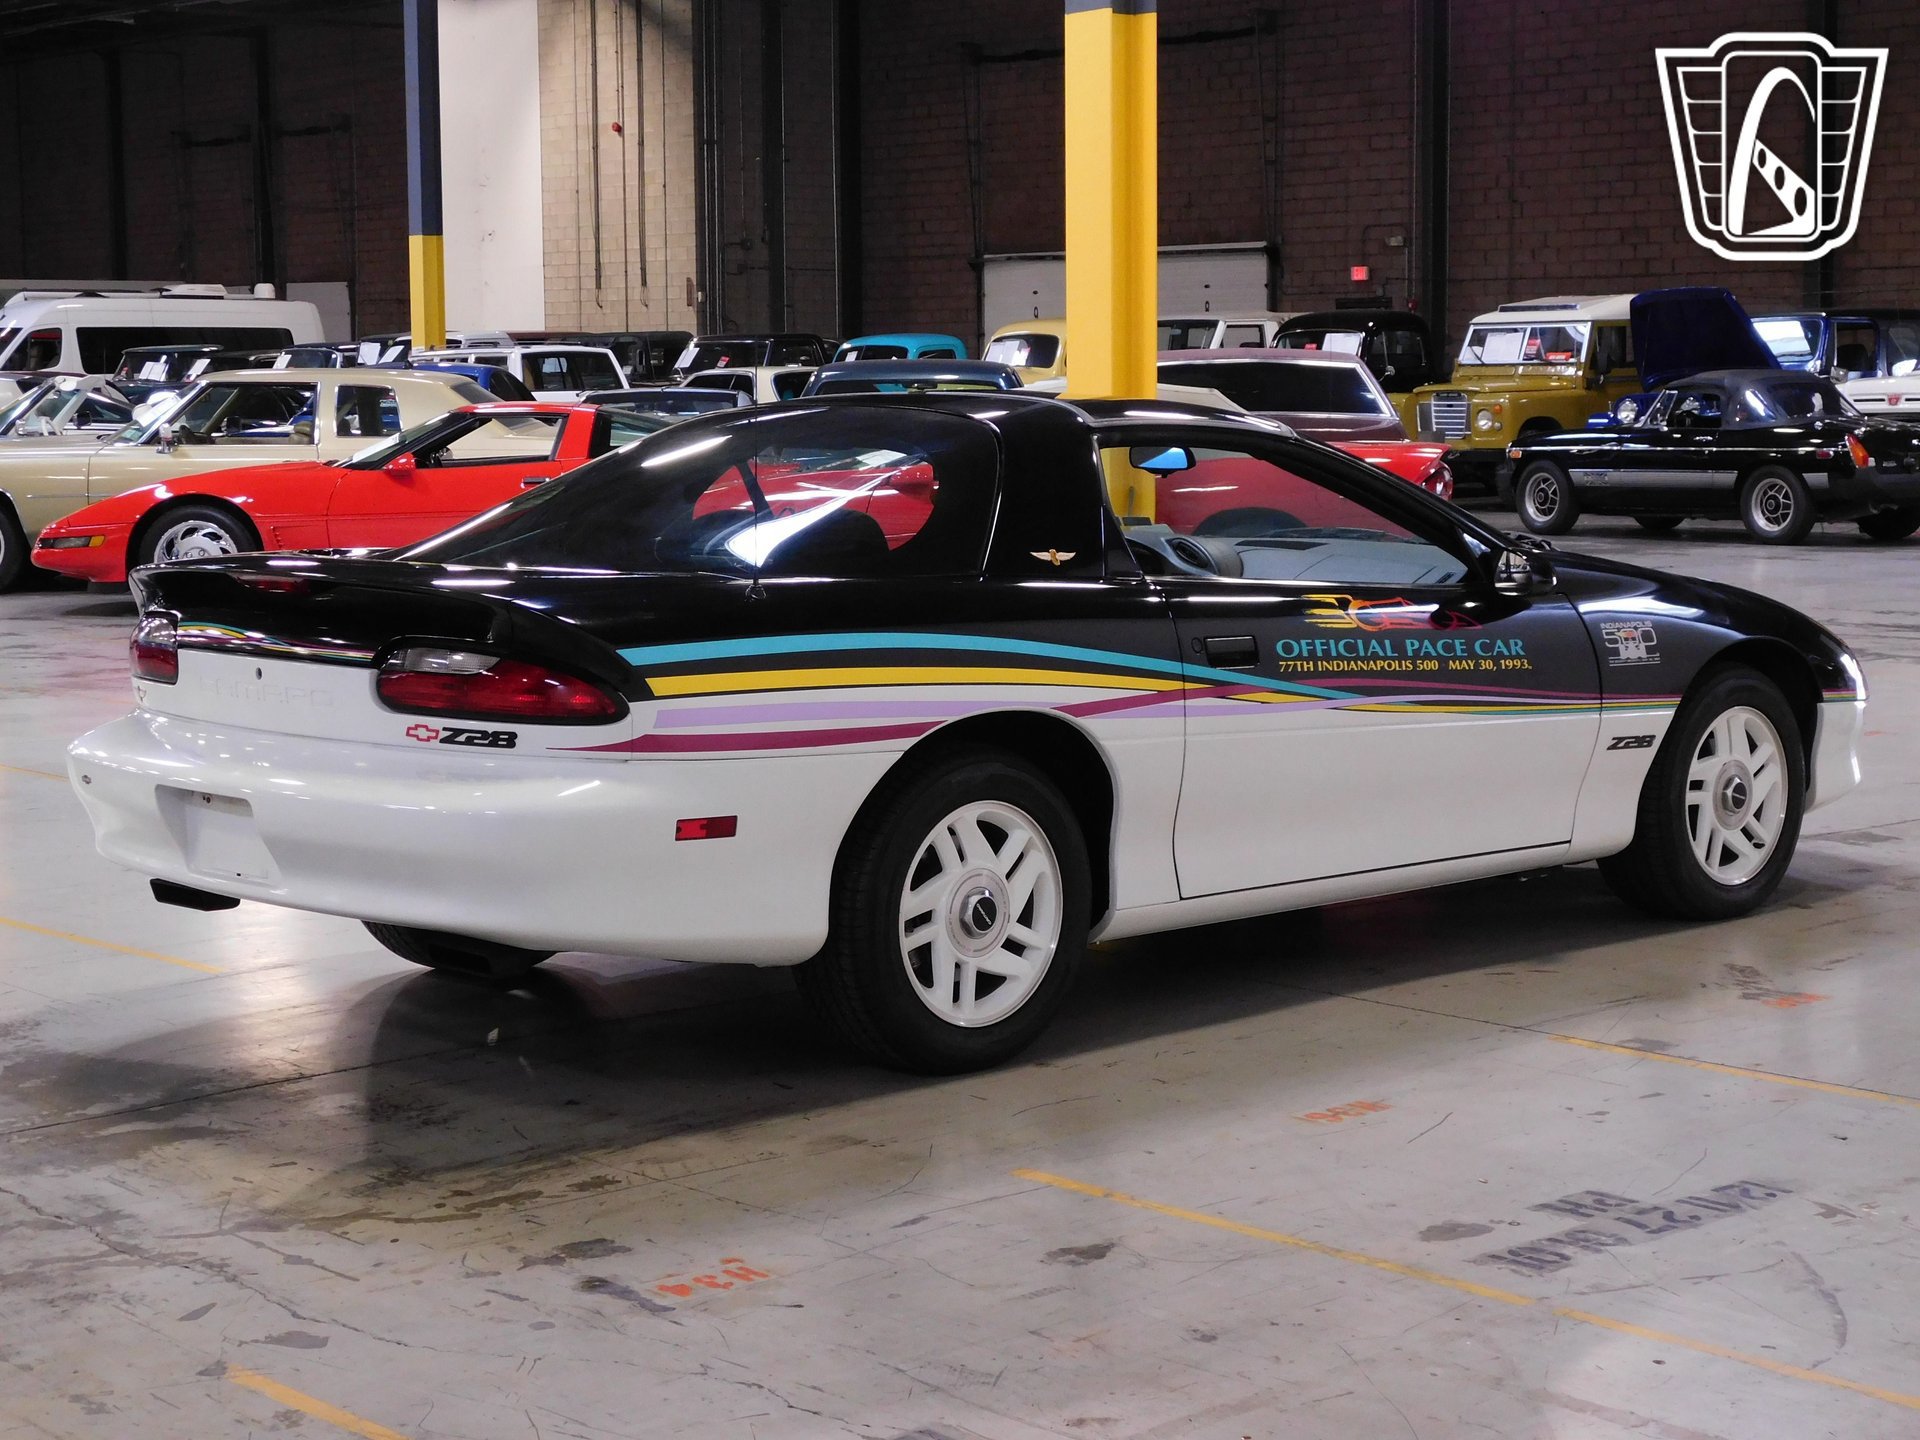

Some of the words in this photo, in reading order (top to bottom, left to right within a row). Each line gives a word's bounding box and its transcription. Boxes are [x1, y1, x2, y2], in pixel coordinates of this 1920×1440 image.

[1600, 621, 1652, 629] INDIANAPOLIS
[1602, 628, 1657, 647] 500
[1276, 639, 1399, 657] OFFICIAL
[1405, 639, 1468, 657] PACE
[1474, 639, 1526, 656] CAR
[1279, 661, 1314, 672] 77TH
[1318, 660, 1413, 671] INDIANAPOLIS
[1416, 660, 1439, 671] 500
[1448, 660, 1476, 670] MAY
[1479, 659, 1497, 671] 30,
[439, 727, 518, 749] Z28
[1606, 735, 1656, 751] Z28
